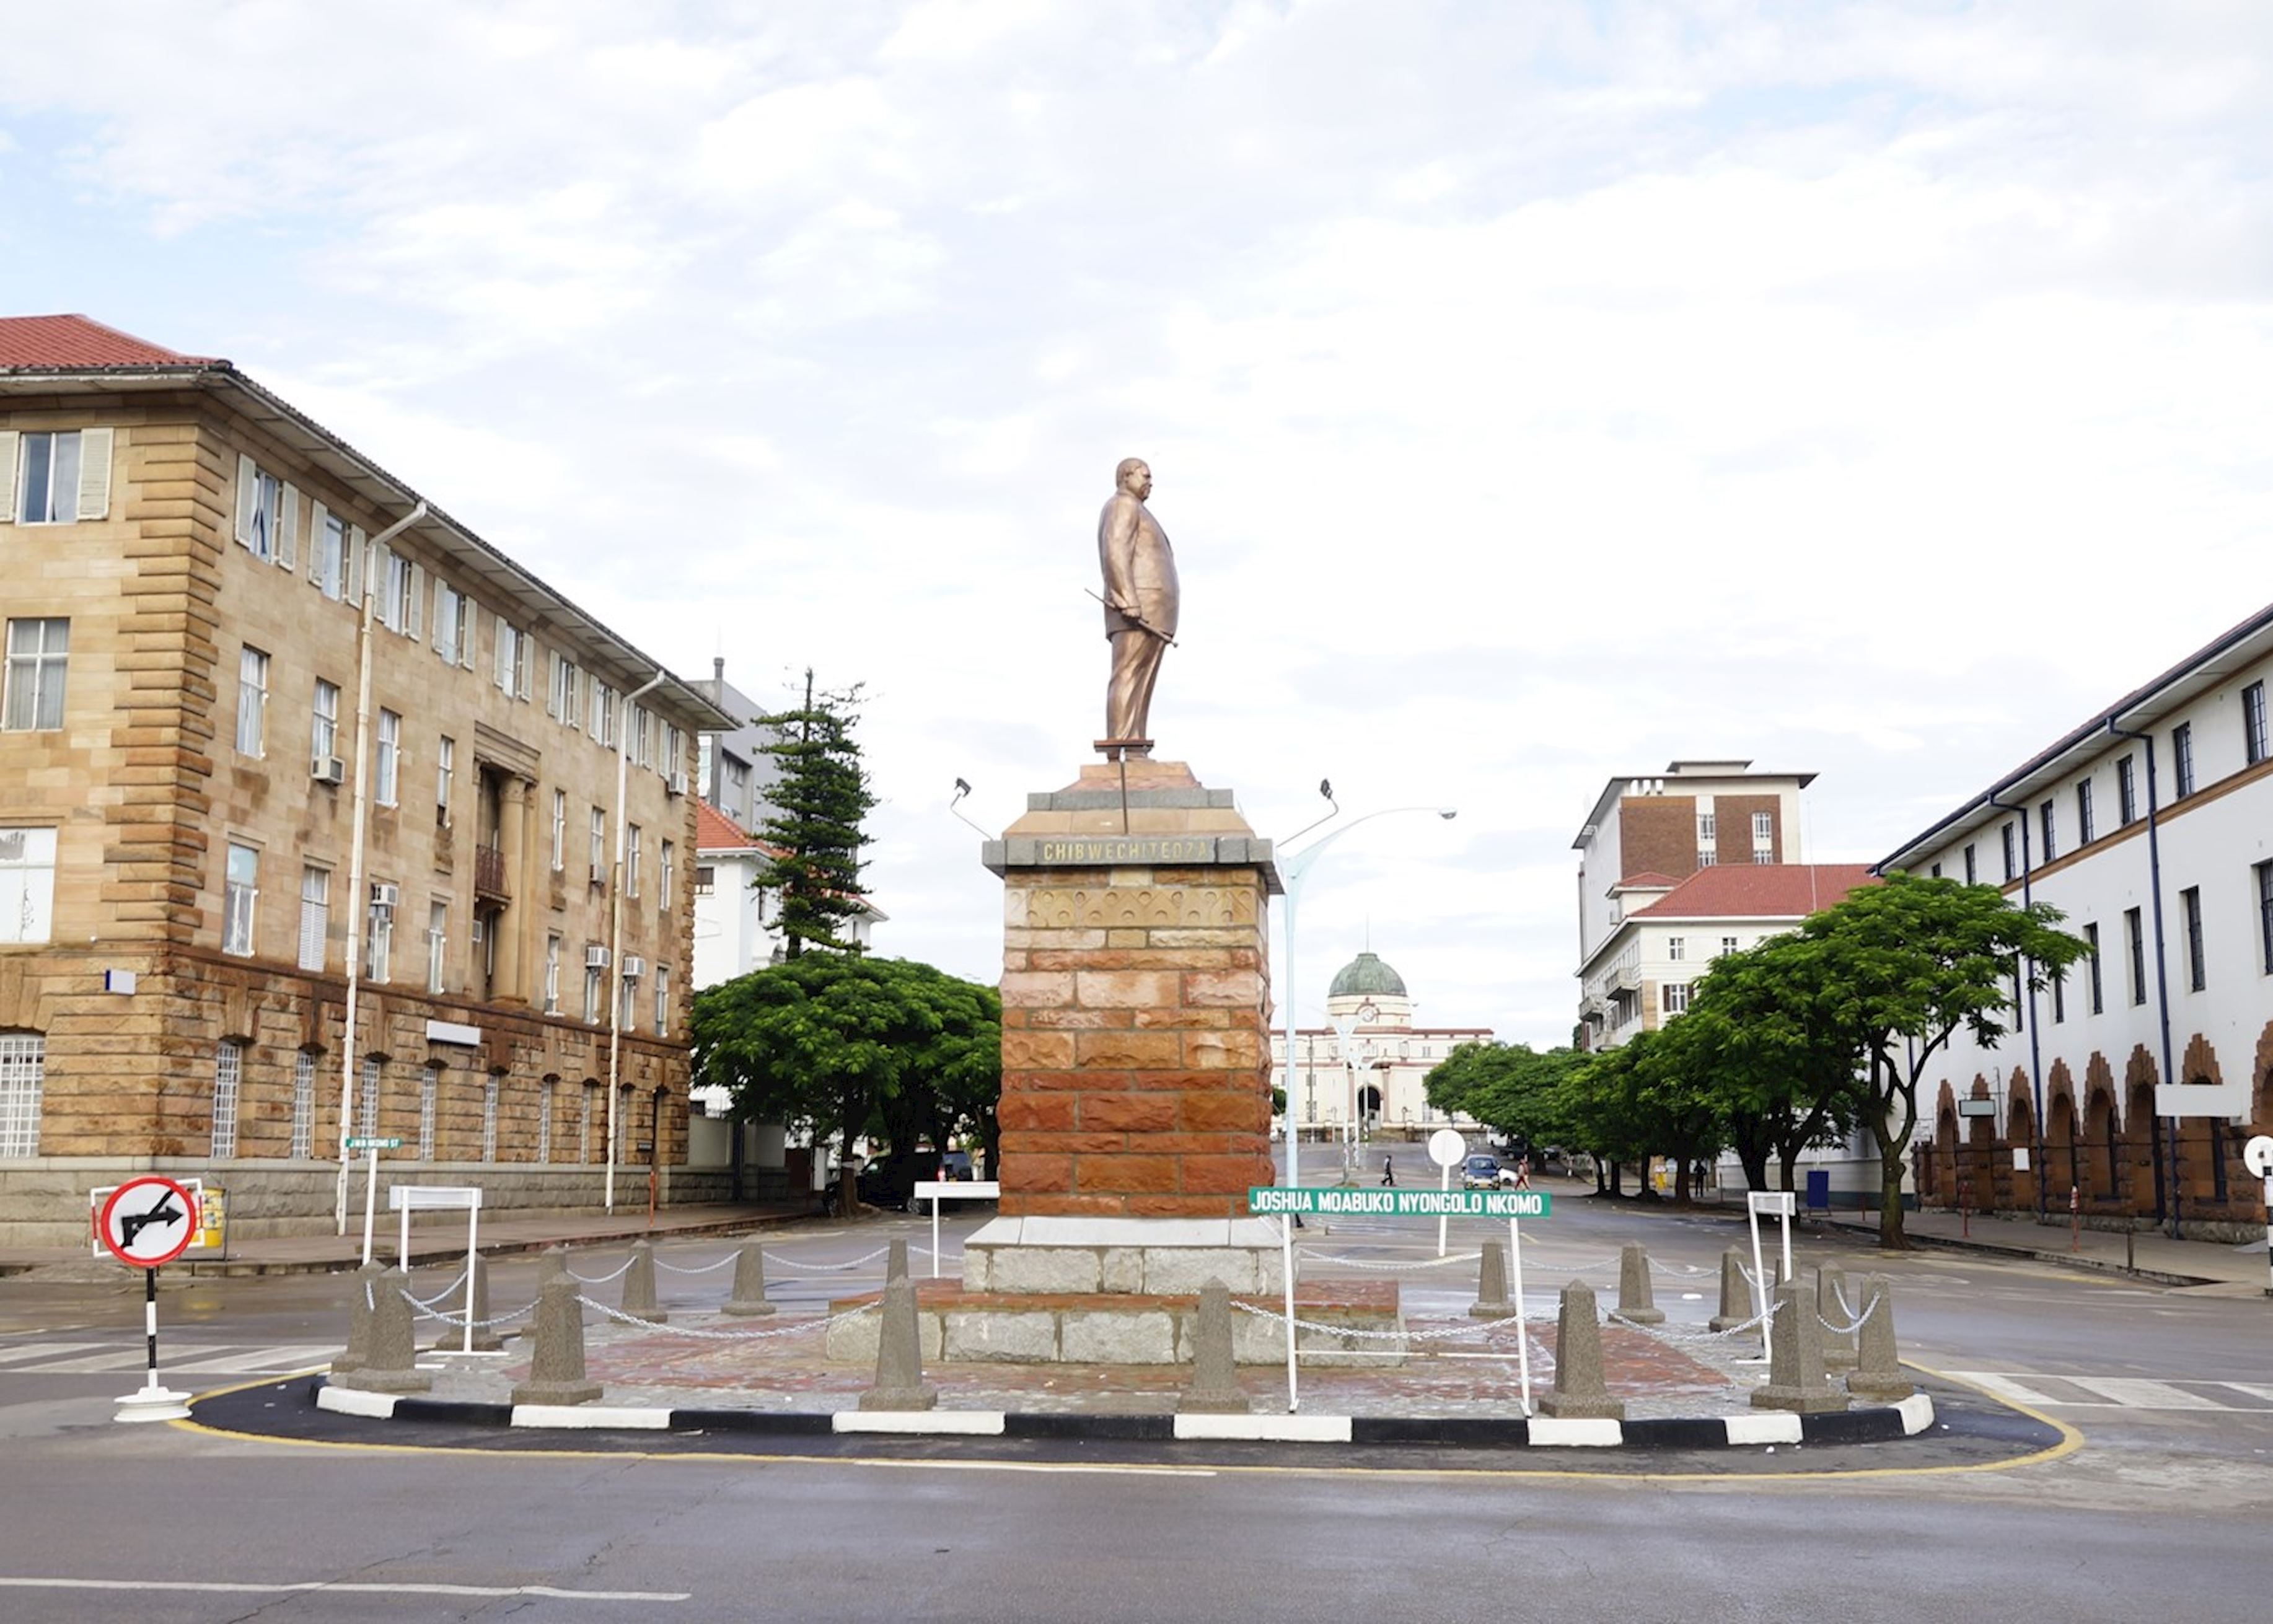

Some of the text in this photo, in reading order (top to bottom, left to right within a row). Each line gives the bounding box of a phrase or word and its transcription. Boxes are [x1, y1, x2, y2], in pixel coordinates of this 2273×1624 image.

[1251, 1191, 1312, 1211] JOSHUA
[1399, 1193, 1482, 1214] NYONGOLO
[1487, 1194, 1542, 1214] NKOMO
